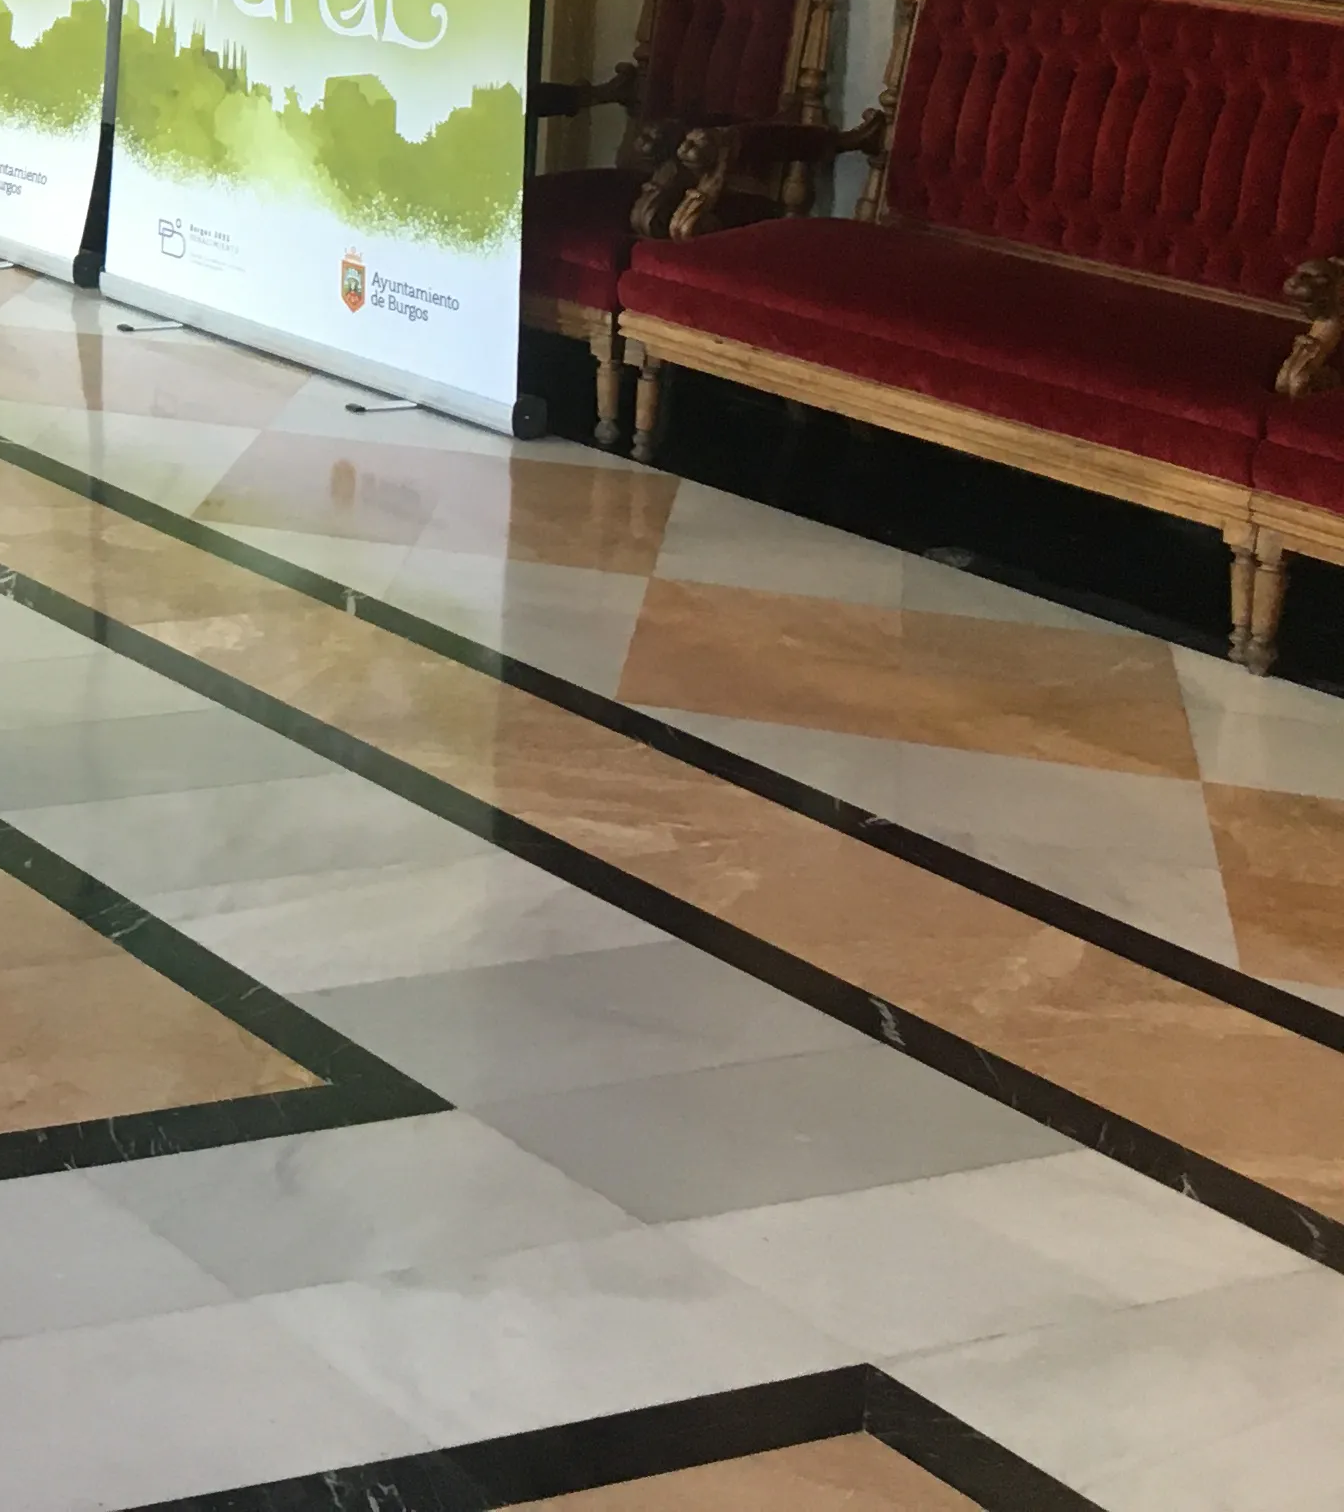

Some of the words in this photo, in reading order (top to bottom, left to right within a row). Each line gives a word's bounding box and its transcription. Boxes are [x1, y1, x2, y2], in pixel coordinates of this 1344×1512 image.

[371, 289, 385, 308] de
[388, 294, 429, 322] Burgos
[372, 271, 460, 311] Ayuntamiento
